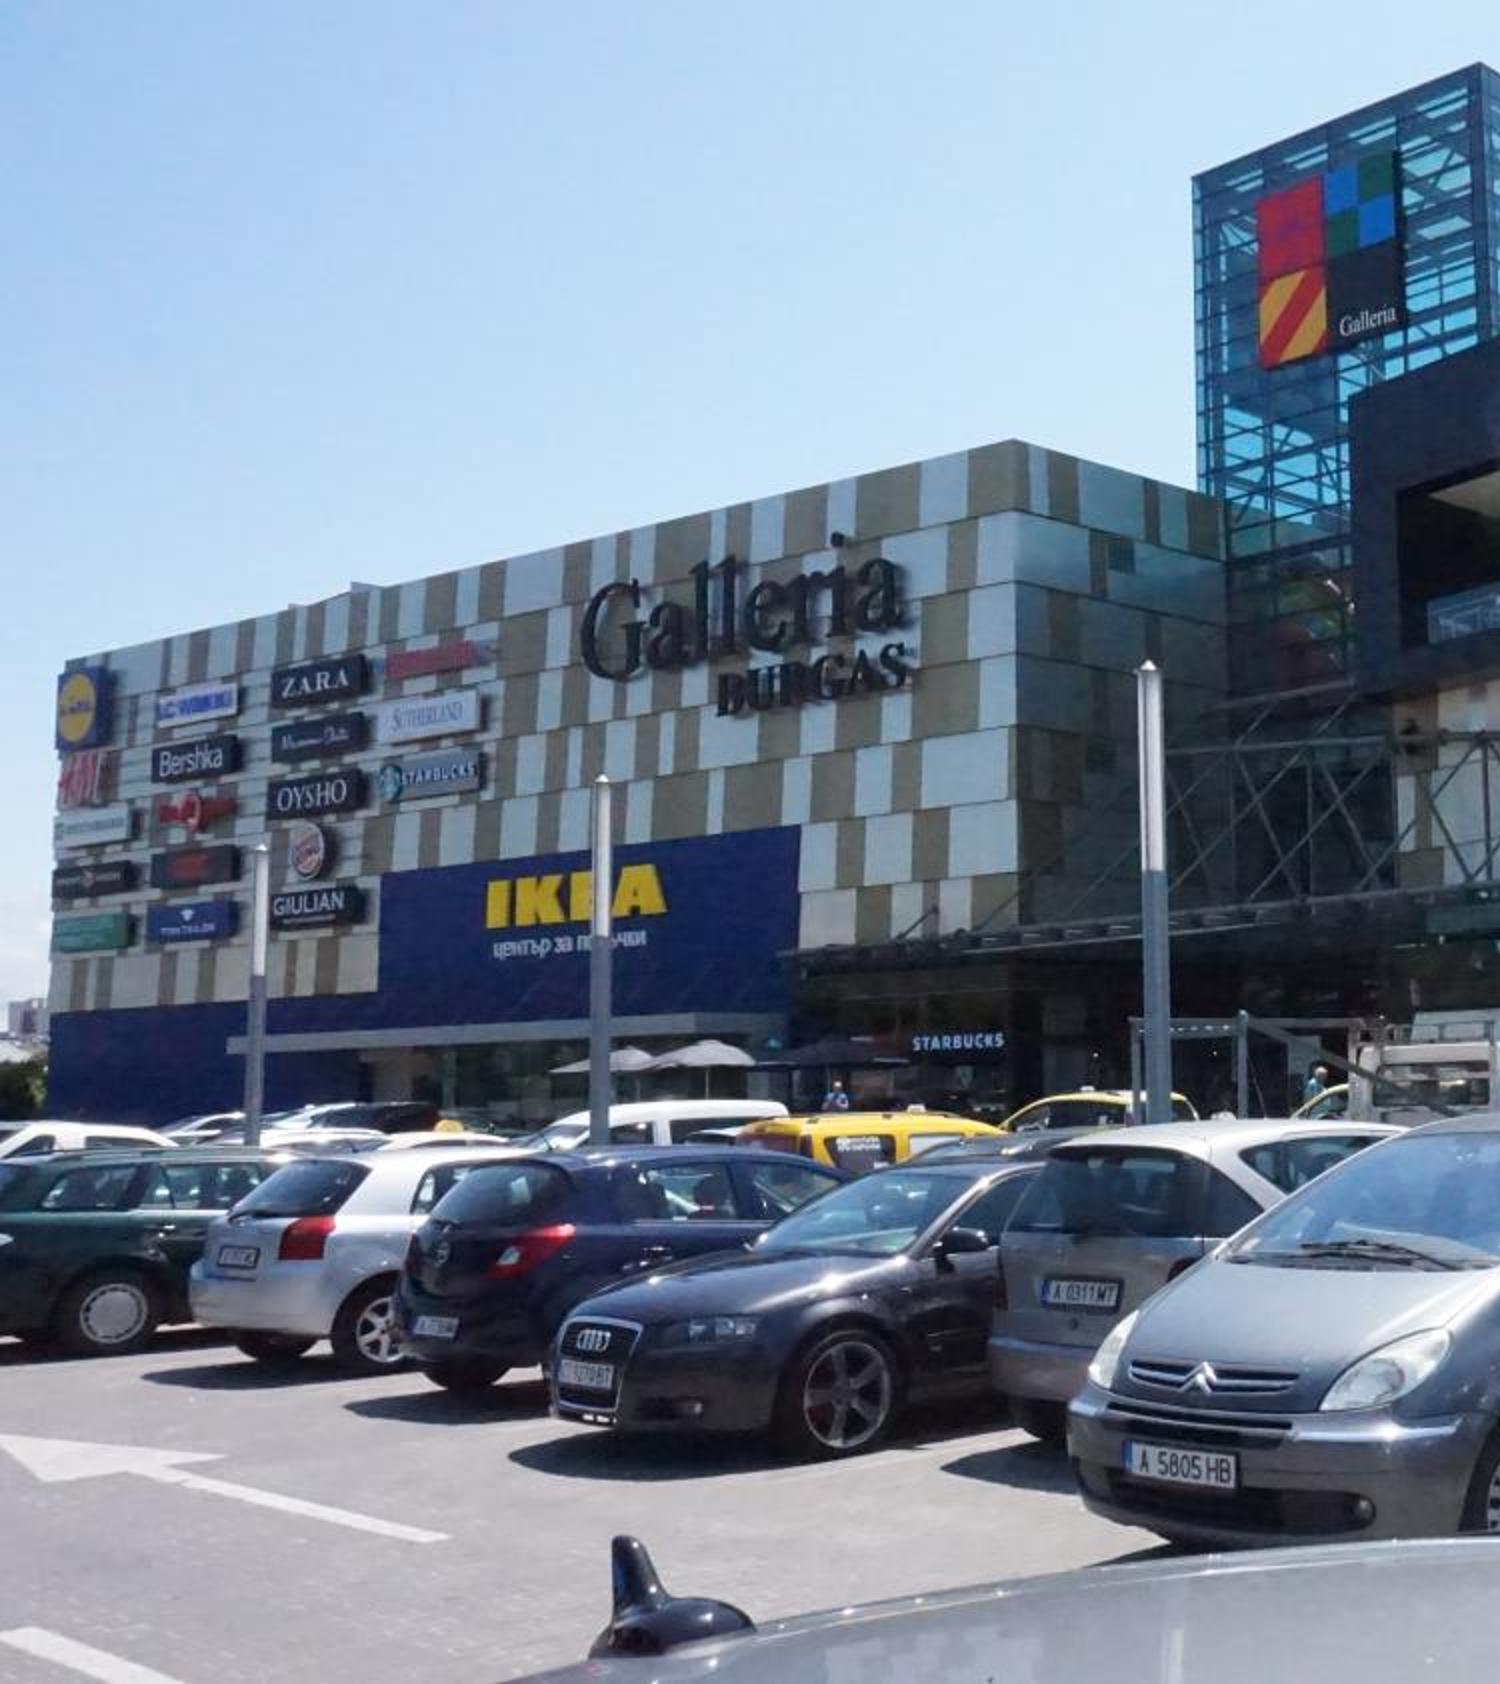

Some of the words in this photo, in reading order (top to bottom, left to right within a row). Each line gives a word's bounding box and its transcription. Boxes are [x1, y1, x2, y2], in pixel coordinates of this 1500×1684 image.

[1339, 303, 1397, 337] Galleria
[580, 531, 906, 682] Galleria
[281, 668, 350, 698] ZARA
[716, 642, 908, 717] BURGAS
[159, 743, 223, 777] Bershka
[401, 762, 476, 785] STARBUCKS
[276, 778, 348, 812] OYSHO
[272, 890, 345, 916] GIULIAN
[486, 864, 668, 929] IKEA
[554, 935, 573, 953] за
[912, 1031, 1005, 1052] STARBUCKS
[1139, 1449, 1149, 1474] A
[1157, 1452, 1201, 1479] 5805
[1205, 1458, 1232, 1484] HB
